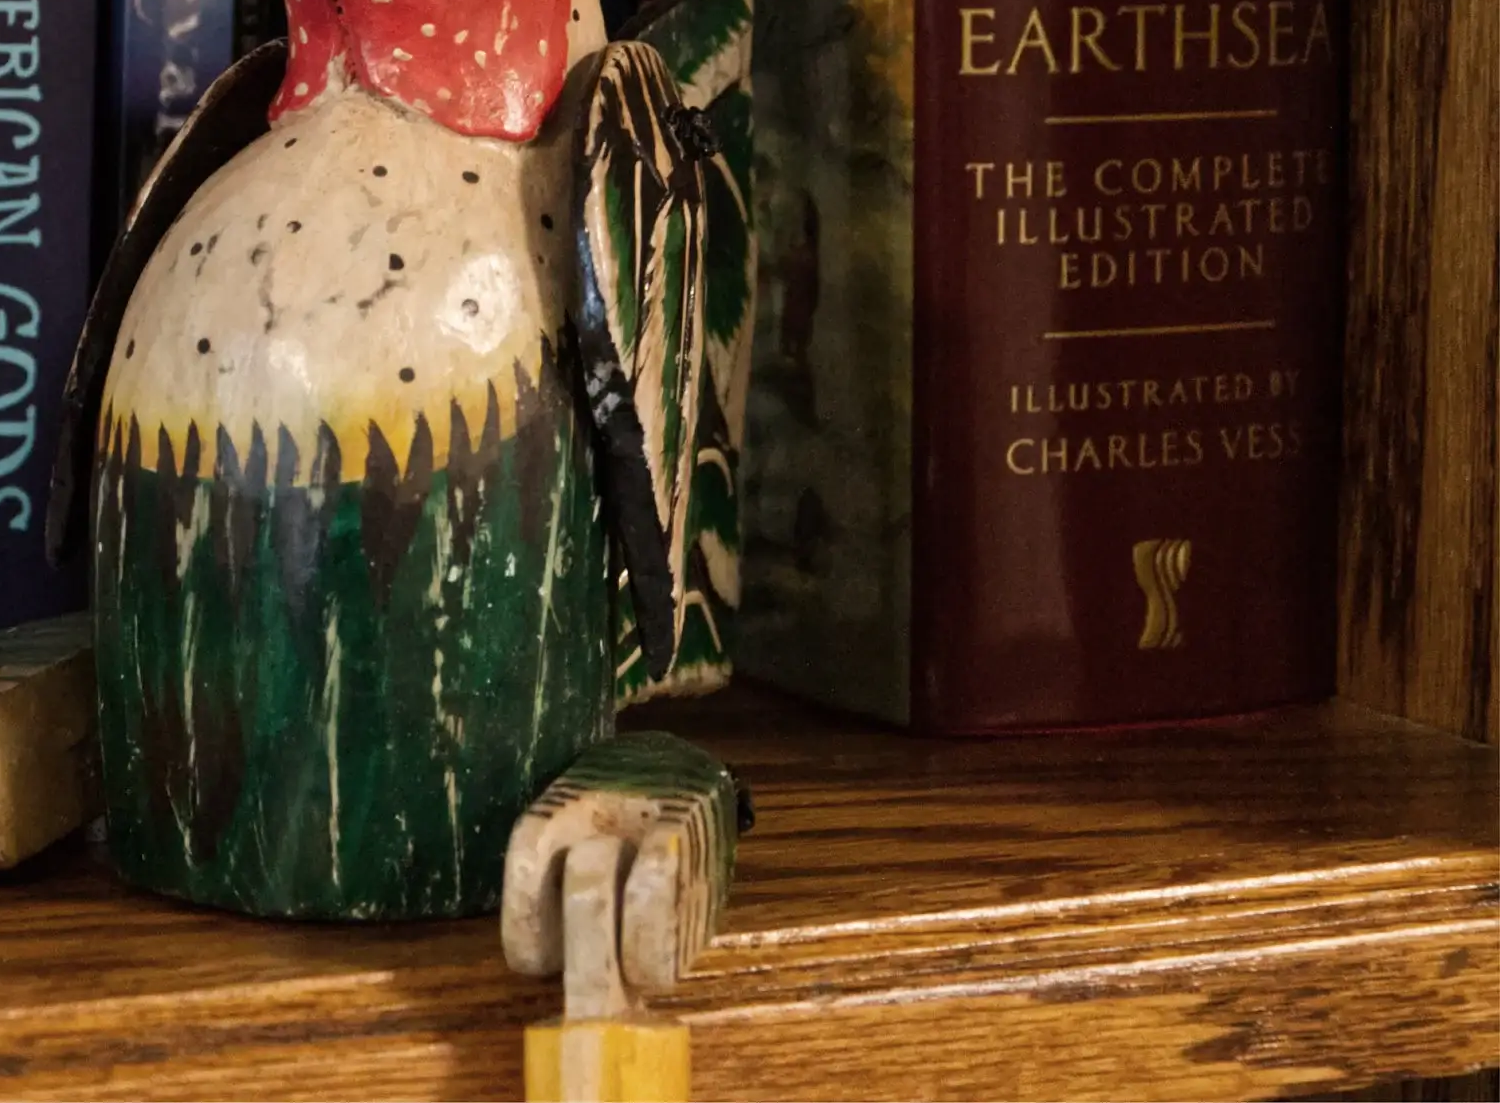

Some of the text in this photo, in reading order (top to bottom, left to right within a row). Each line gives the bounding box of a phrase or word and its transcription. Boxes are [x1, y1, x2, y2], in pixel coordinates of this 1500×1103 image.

[958, 1, 1334, 75] EARTHSEA
[965, 159, 1068, 199] THE
[996, 198, 1313, 246] ILLUSTRATED
[1060, 244, 1265, 289] EDITION
[1010, 373, 1254, 414] ILLUSTRATED
[1005, 422, 1304, 476] CHARLES VESS
